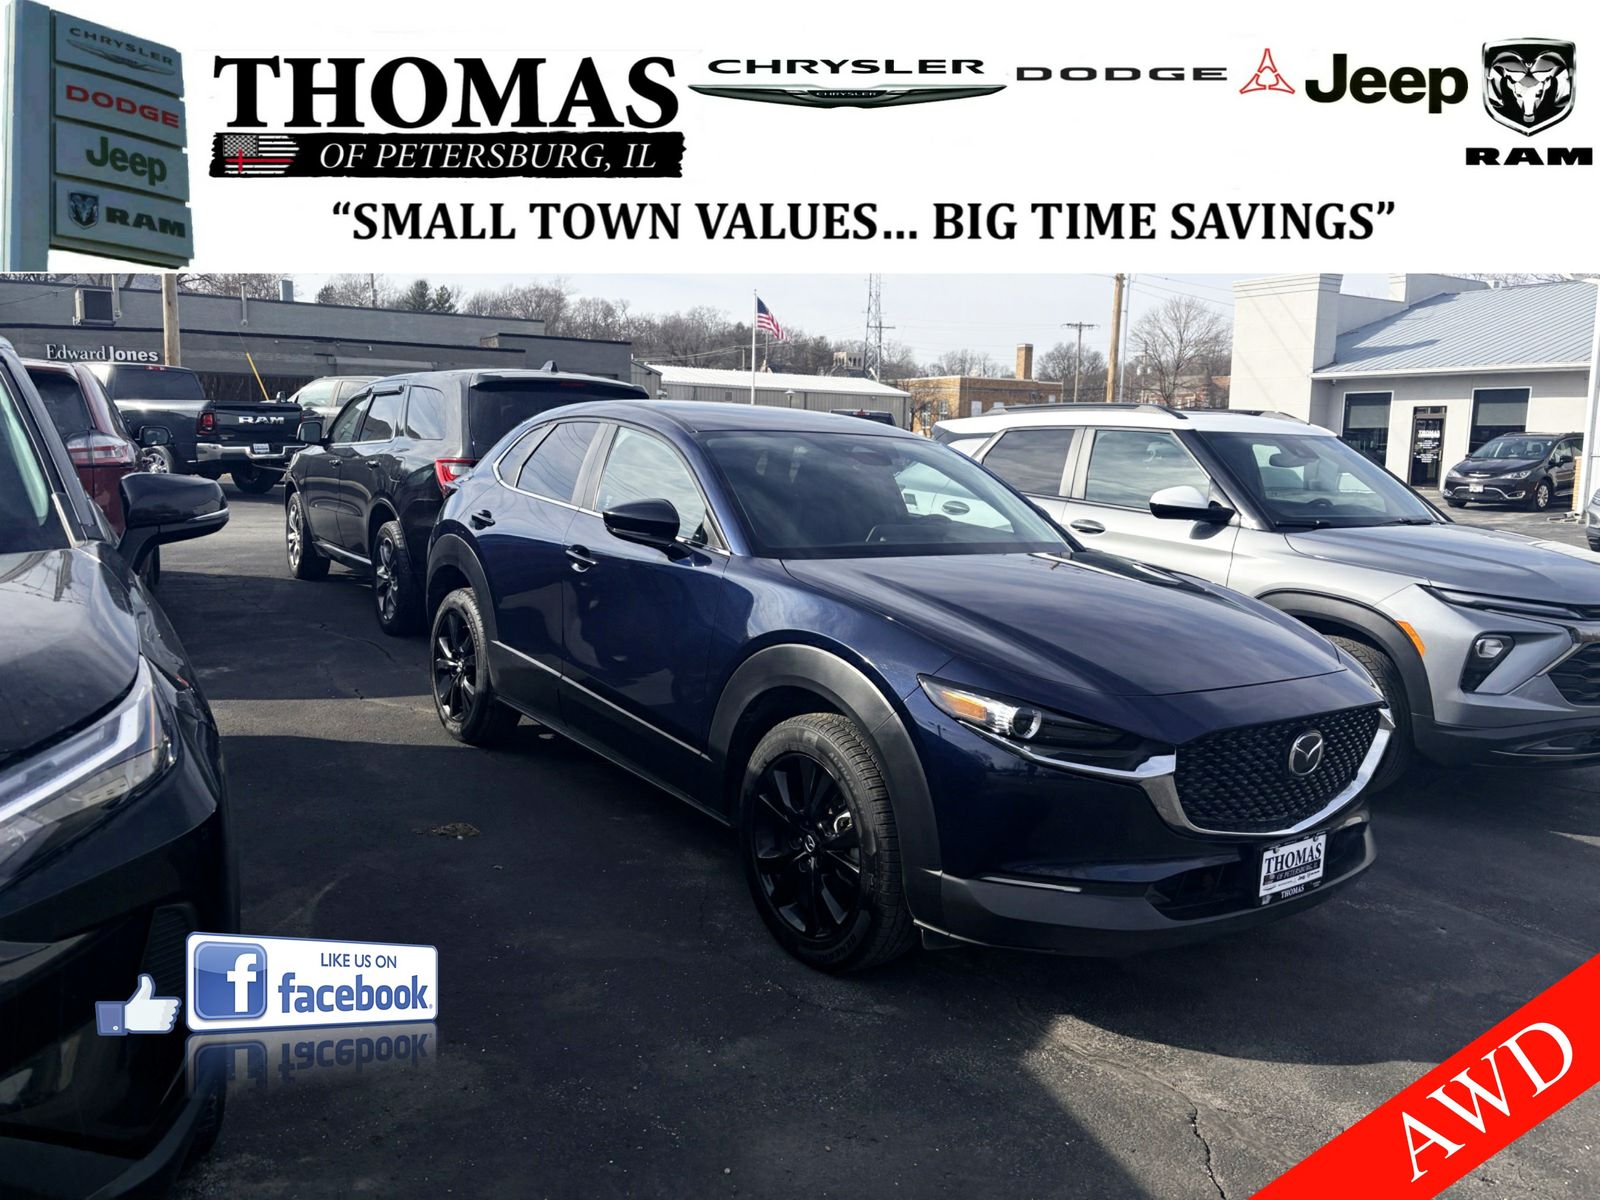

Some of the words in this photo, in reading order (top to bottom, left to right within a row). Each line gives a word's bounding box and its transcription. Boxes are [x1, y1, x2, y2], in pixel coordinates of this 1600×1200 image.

[46, 343, 106, 360] Edward
[107, 345, 159, 362] Jones
[238, 416, 285, 424] RAM
[1264, 842, 1322, 874] THOMAS
[1280, 884, 1305, 899] THOMAS
